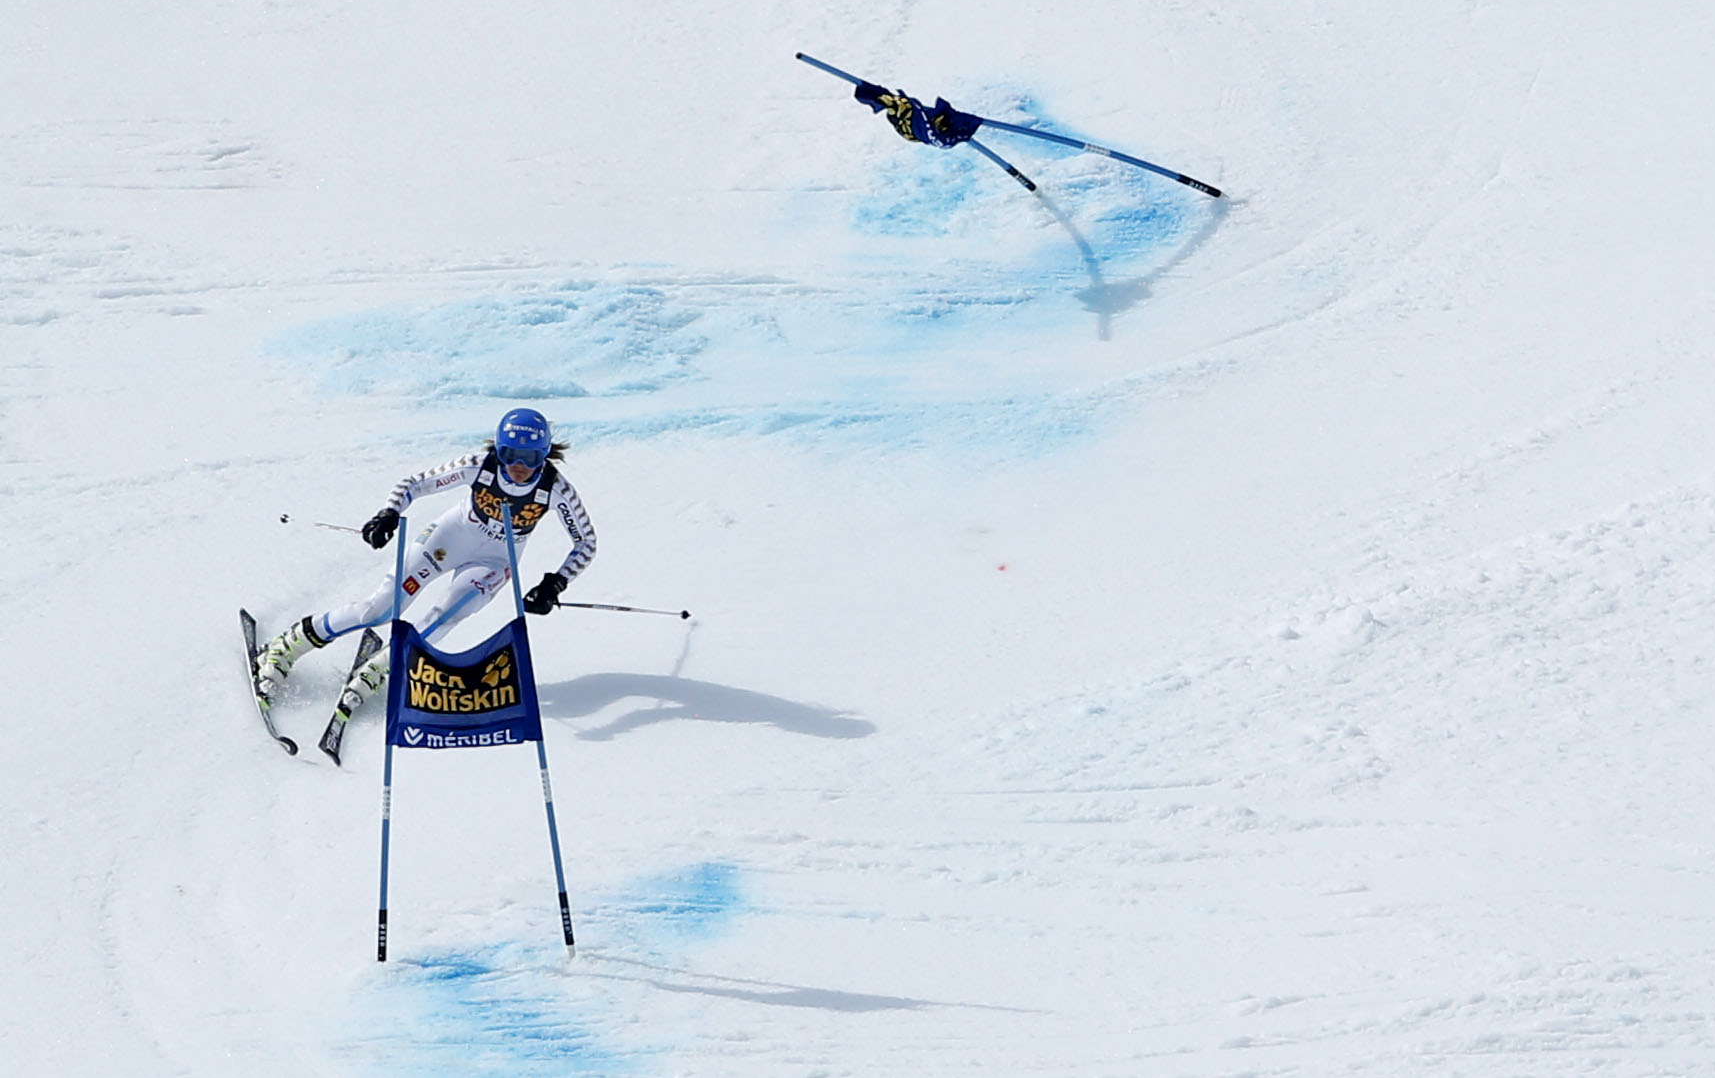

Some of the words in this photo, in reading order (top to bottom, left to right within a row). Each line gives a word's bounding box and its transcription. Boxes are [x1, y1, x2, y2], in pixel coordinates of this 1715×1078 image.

[435, 471, 462, 489] Audi
[557, 503, 582, 543] GOLDWIN
[409, 680, 516, 712] Wolfskin
[427, 729, 517, 747] MÉRIBEL
